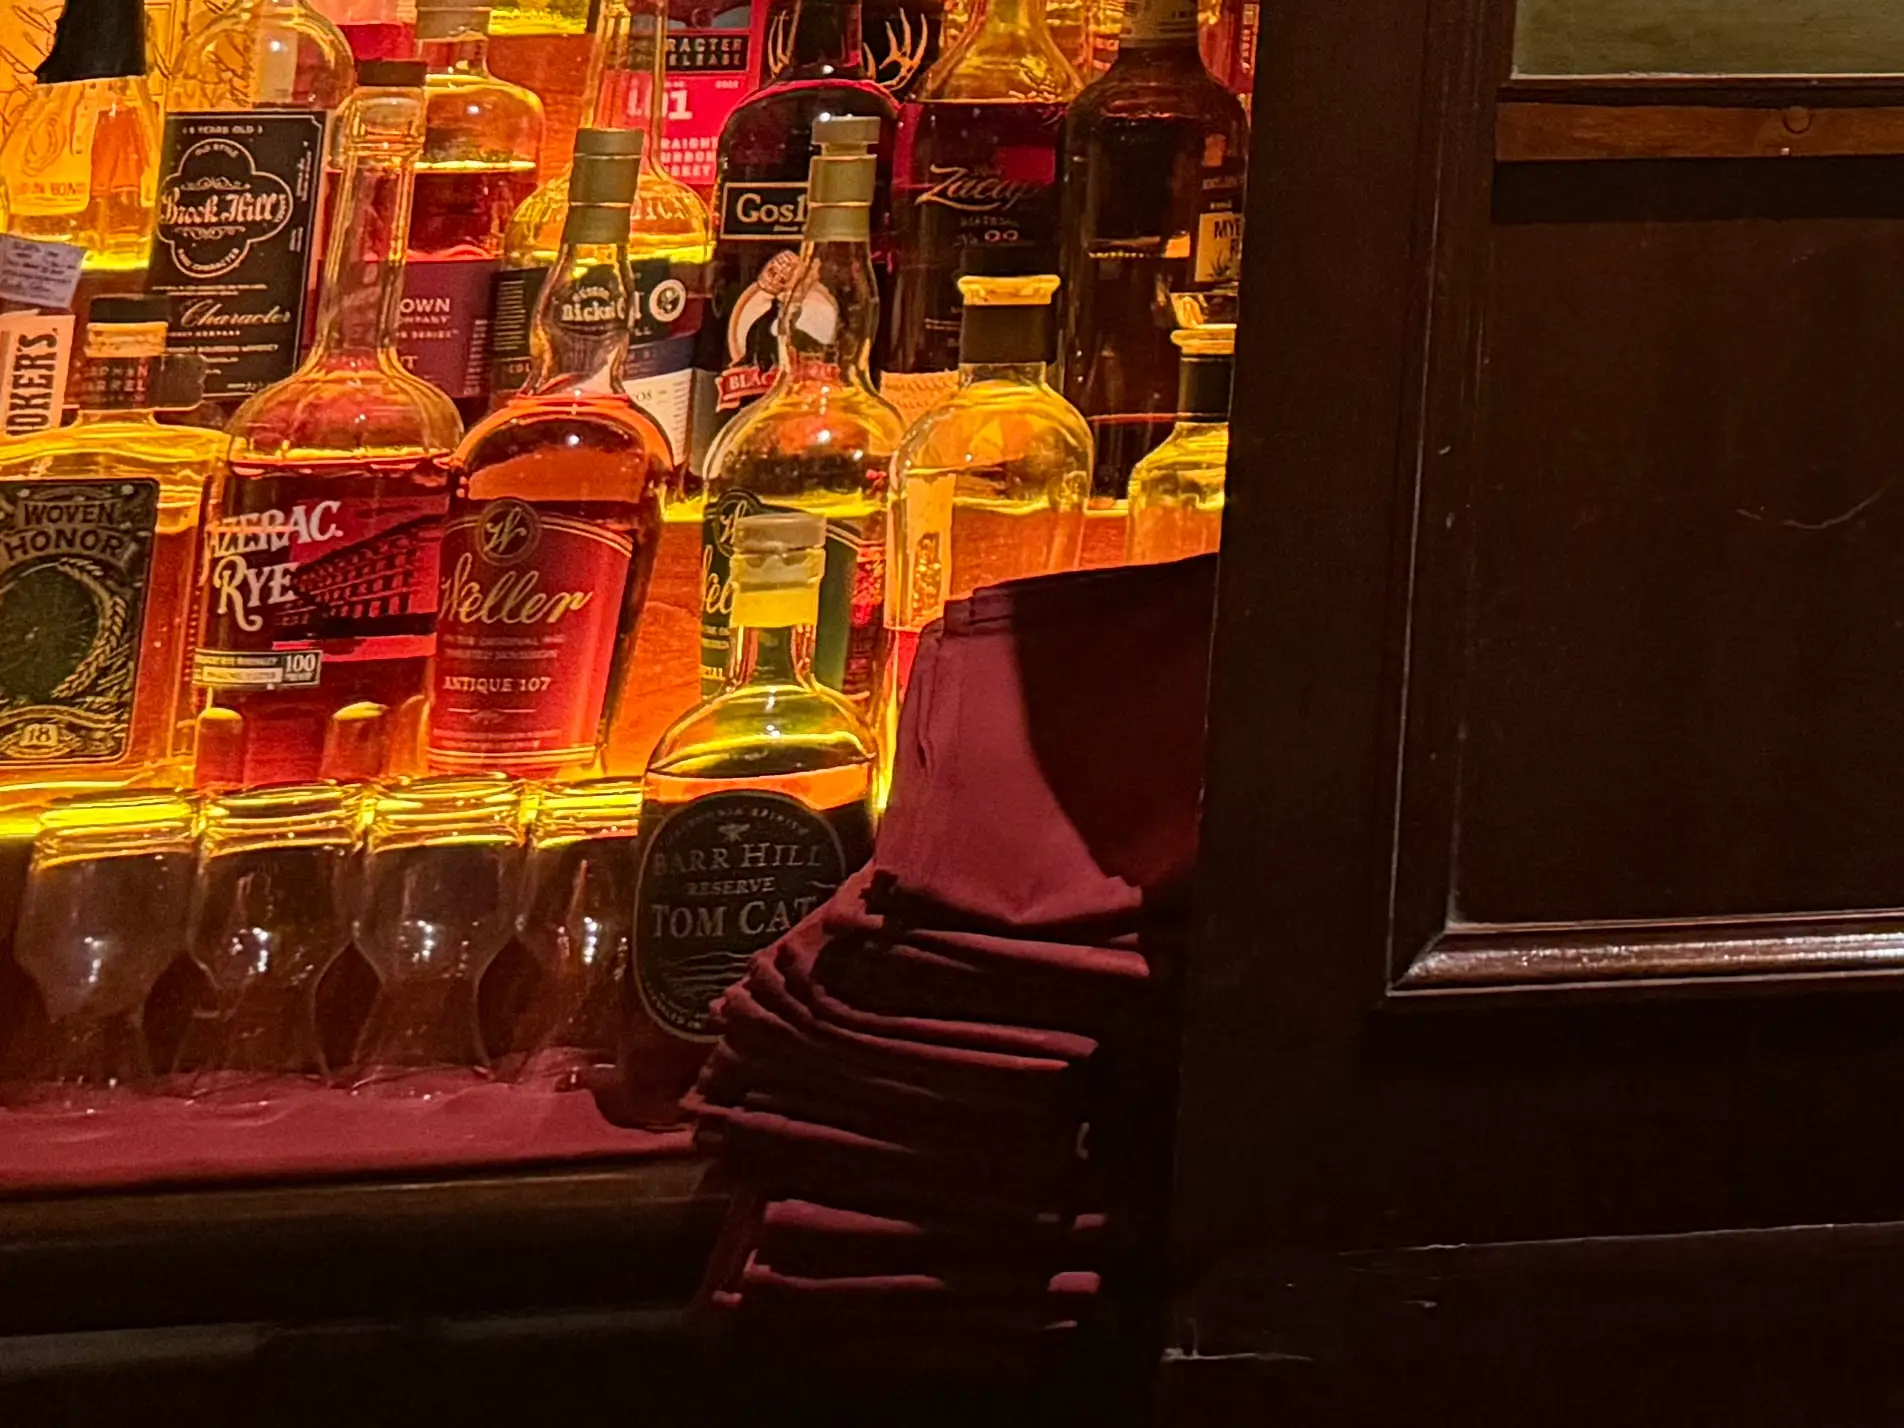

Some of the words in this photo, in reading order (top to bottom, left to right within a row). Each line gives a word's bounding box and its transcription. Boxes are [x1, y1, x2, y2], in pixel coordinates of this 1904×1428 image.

[666, 37, 744, 53] RACTER
[667, 53, 742, 67] ELEASE
[660, 136, 719, 150] RAIGHT
[220, 190, 278, 224] Hill
[735, 193, 808, 225] Gosl
[6, 327, 59, 436] OKER'S
[728, 374, 772, 391] BLAC
[23, 502, 118, 526] WOVEN
[212, 499, 344, 558] ZERAC.
[4, 528, 123, 560] HONOR
[212, 555, 300, 632] RYE
[438, 552, 594, 624] Weller
[284, 653, 316, 675] 100
[519, 676, 552, 692] 107
[740, 842, 824, 868] HILL
[651, 904, 729, 939] TOM
